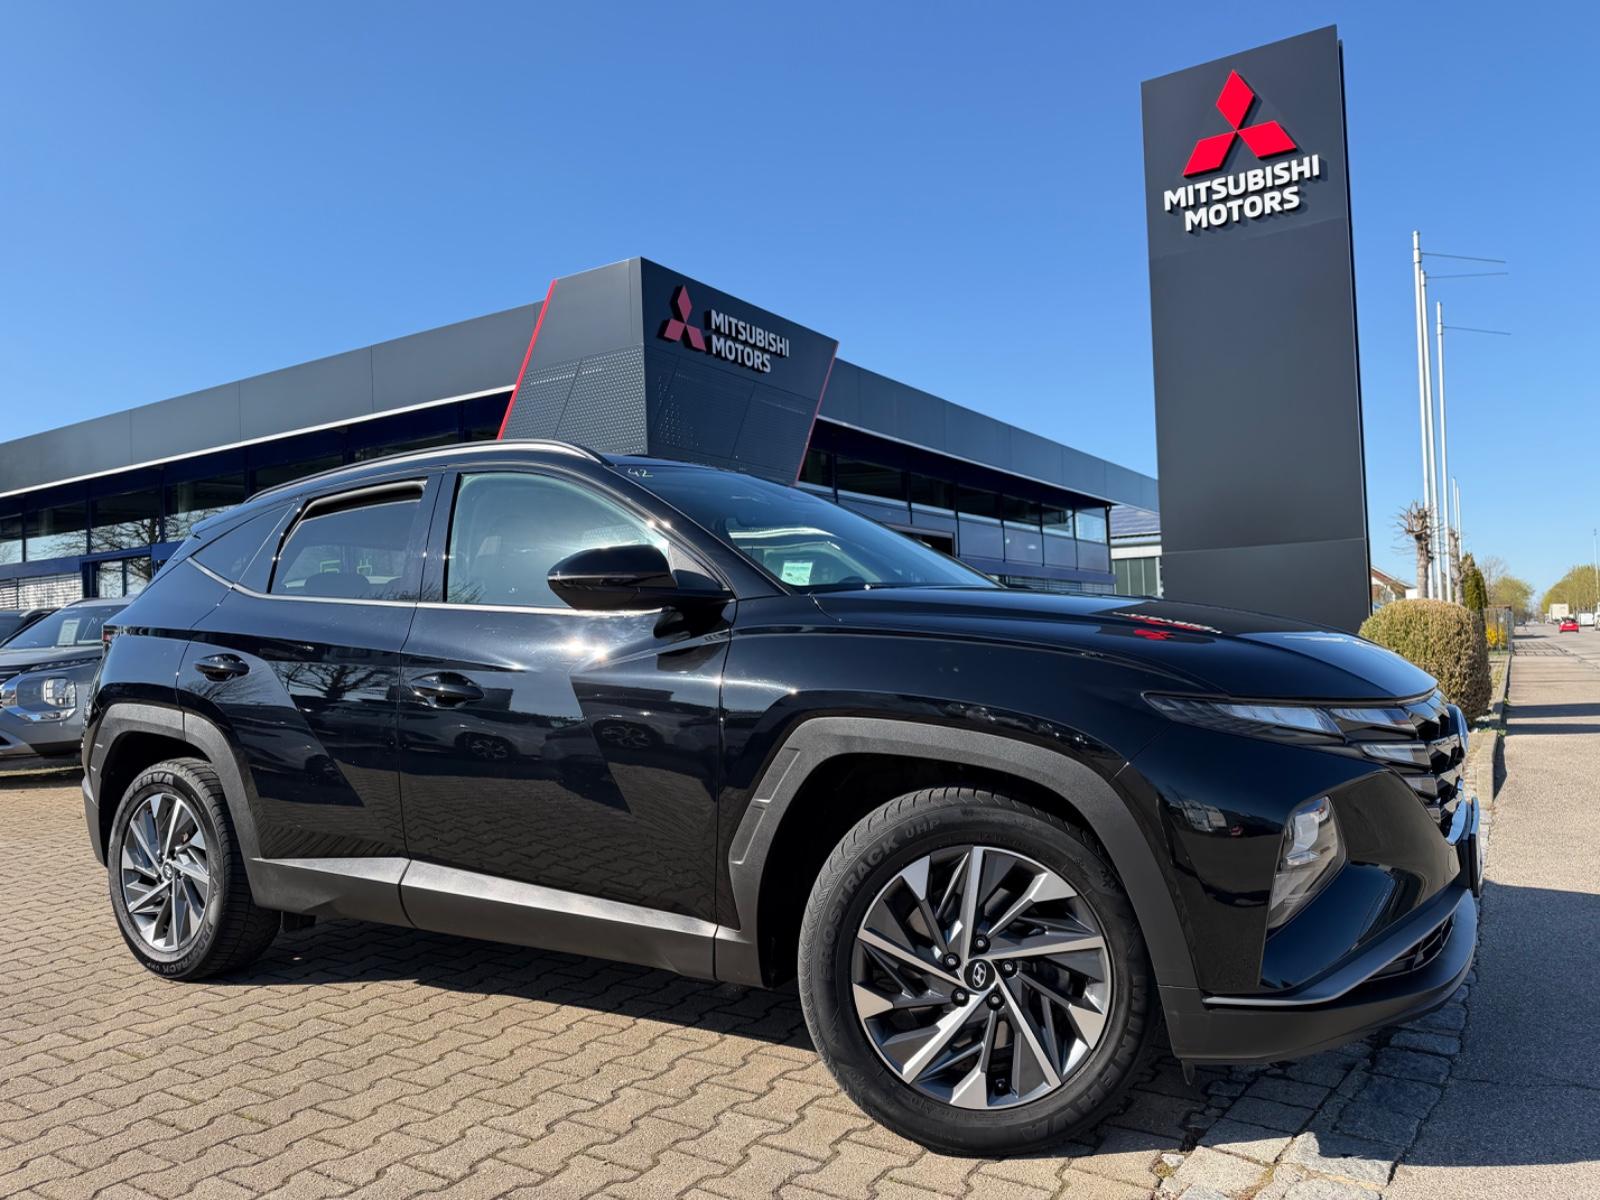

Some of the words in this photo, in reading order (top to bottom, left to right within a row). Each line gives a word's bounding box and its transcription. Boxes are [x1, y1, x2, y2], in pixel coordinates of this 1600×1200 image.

[1163, 153, 1320, 211] MITSUBISHI
[1184, 186, 1300, 232] MOTORS
[710, 309, 790, 358] MITSUBISHI
[711, 335, 771, 373] MOTORS
[817, 832, 901, 980] FROSTRACK
[1019, 974, 1148, 1139] MINERVA
